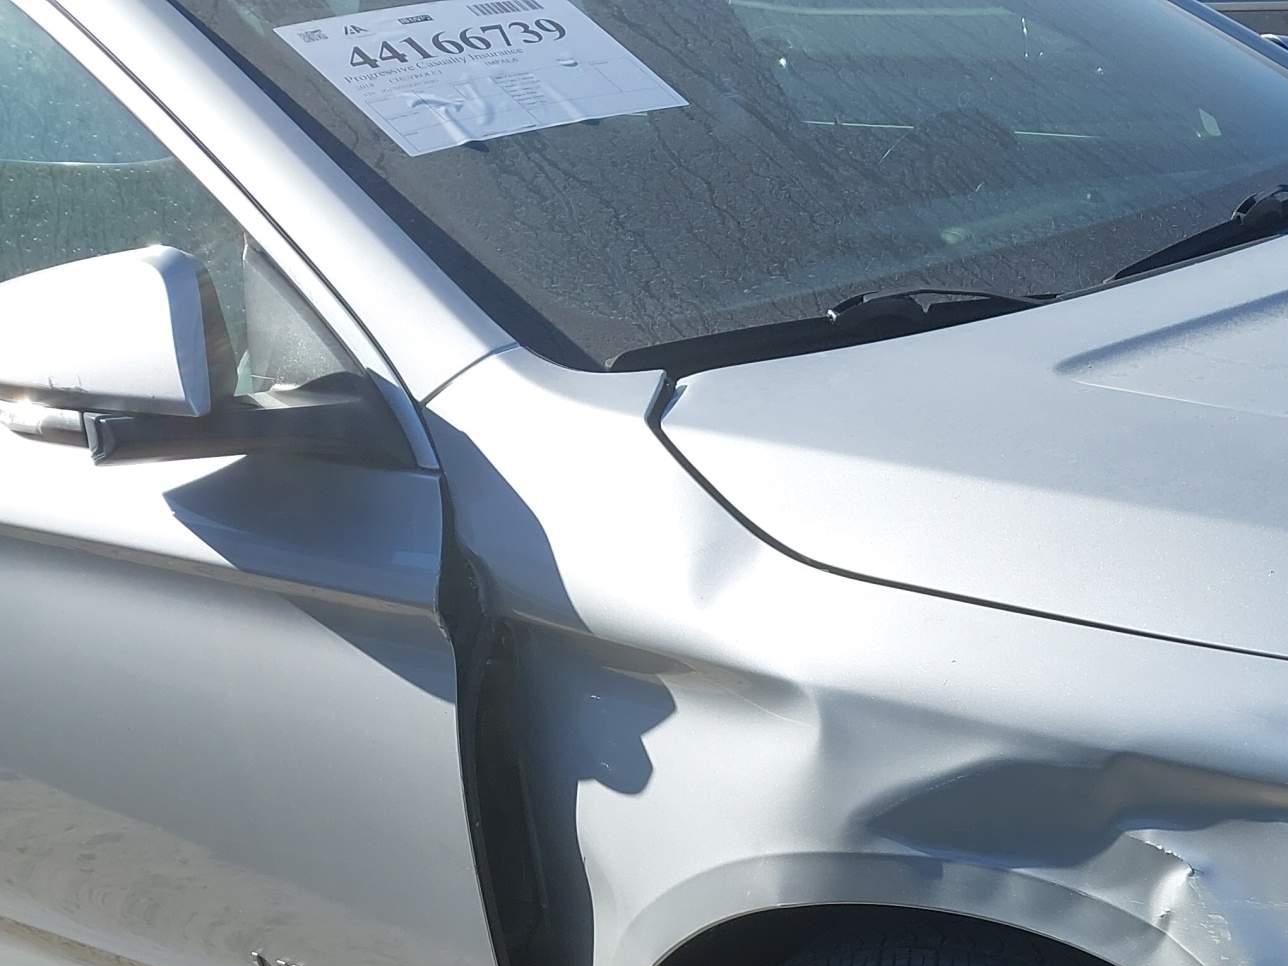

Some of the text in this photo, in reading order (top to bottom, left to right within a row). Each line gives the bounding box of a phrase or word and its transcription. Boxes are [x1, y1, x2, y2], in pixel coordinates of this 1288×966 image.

[348, 17, 567, 69] 44166739
[344, 48, 524, 83] Progressive Casualty Insurance
